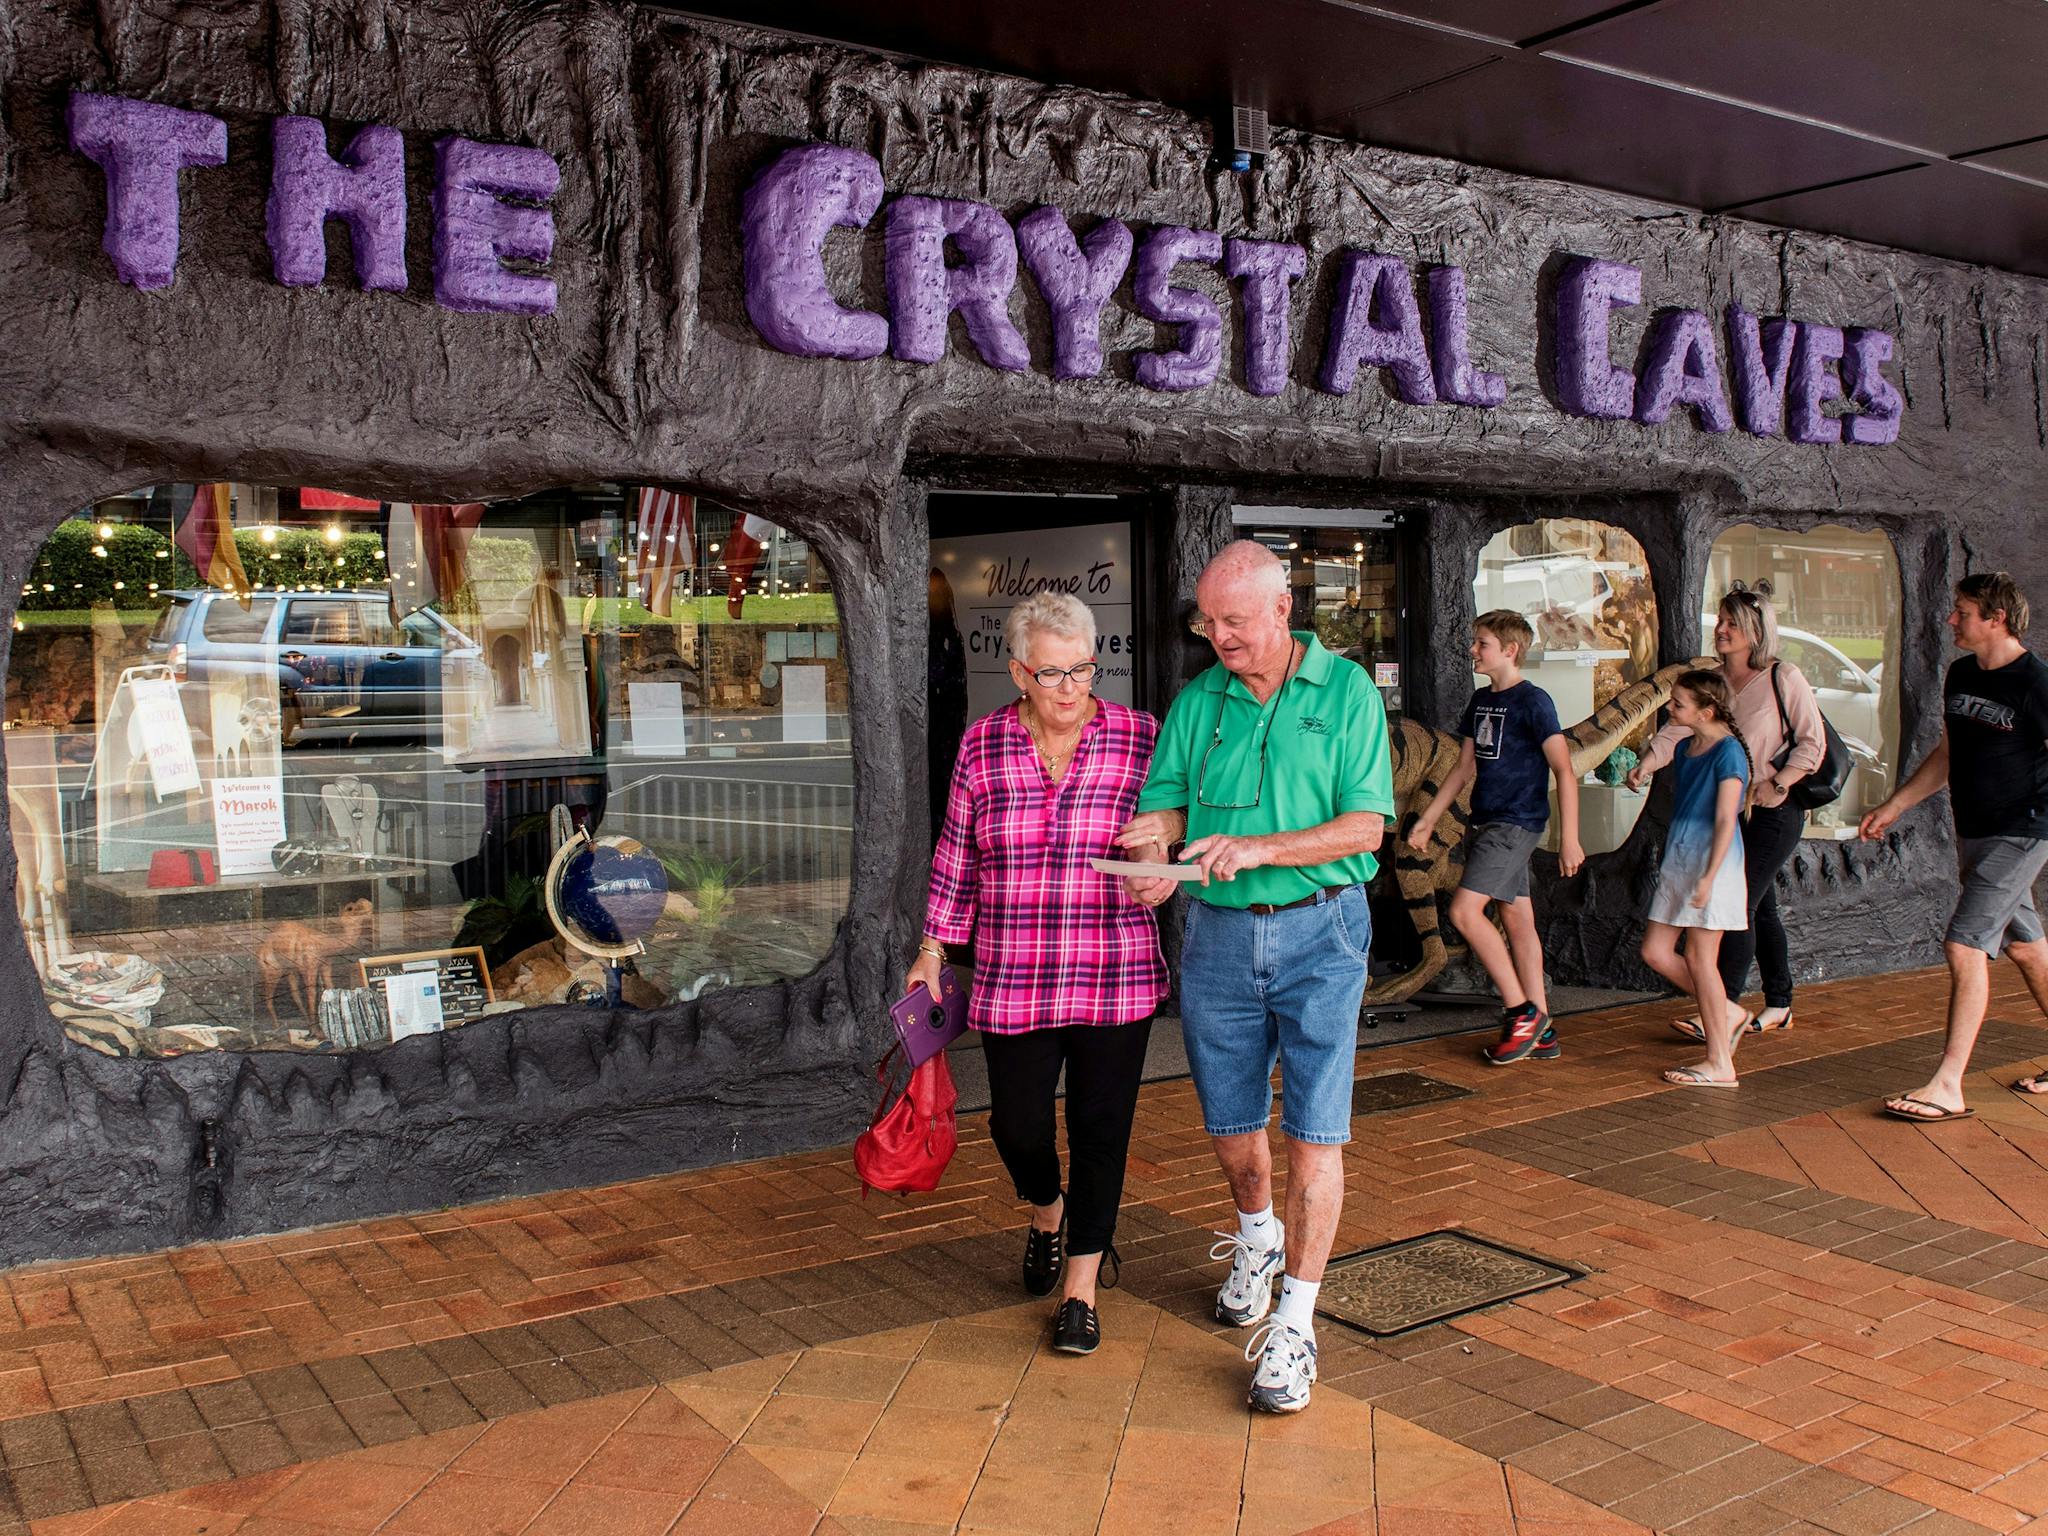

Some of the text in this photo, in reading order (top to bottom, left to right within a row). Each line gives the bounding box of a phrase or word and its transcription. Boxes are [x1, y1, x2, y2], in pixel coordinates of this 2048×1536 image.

[67, 92, 1903, 446] THE CRYSTAL CAVES
[983, 556, 1115, 598] Welcome to
[981, 615, 1001, 630] The
[1096, 634, 1133, 655] ves
[222, 783, 272, 793] Welcome to
[219, 797, 277, 816] Marok
